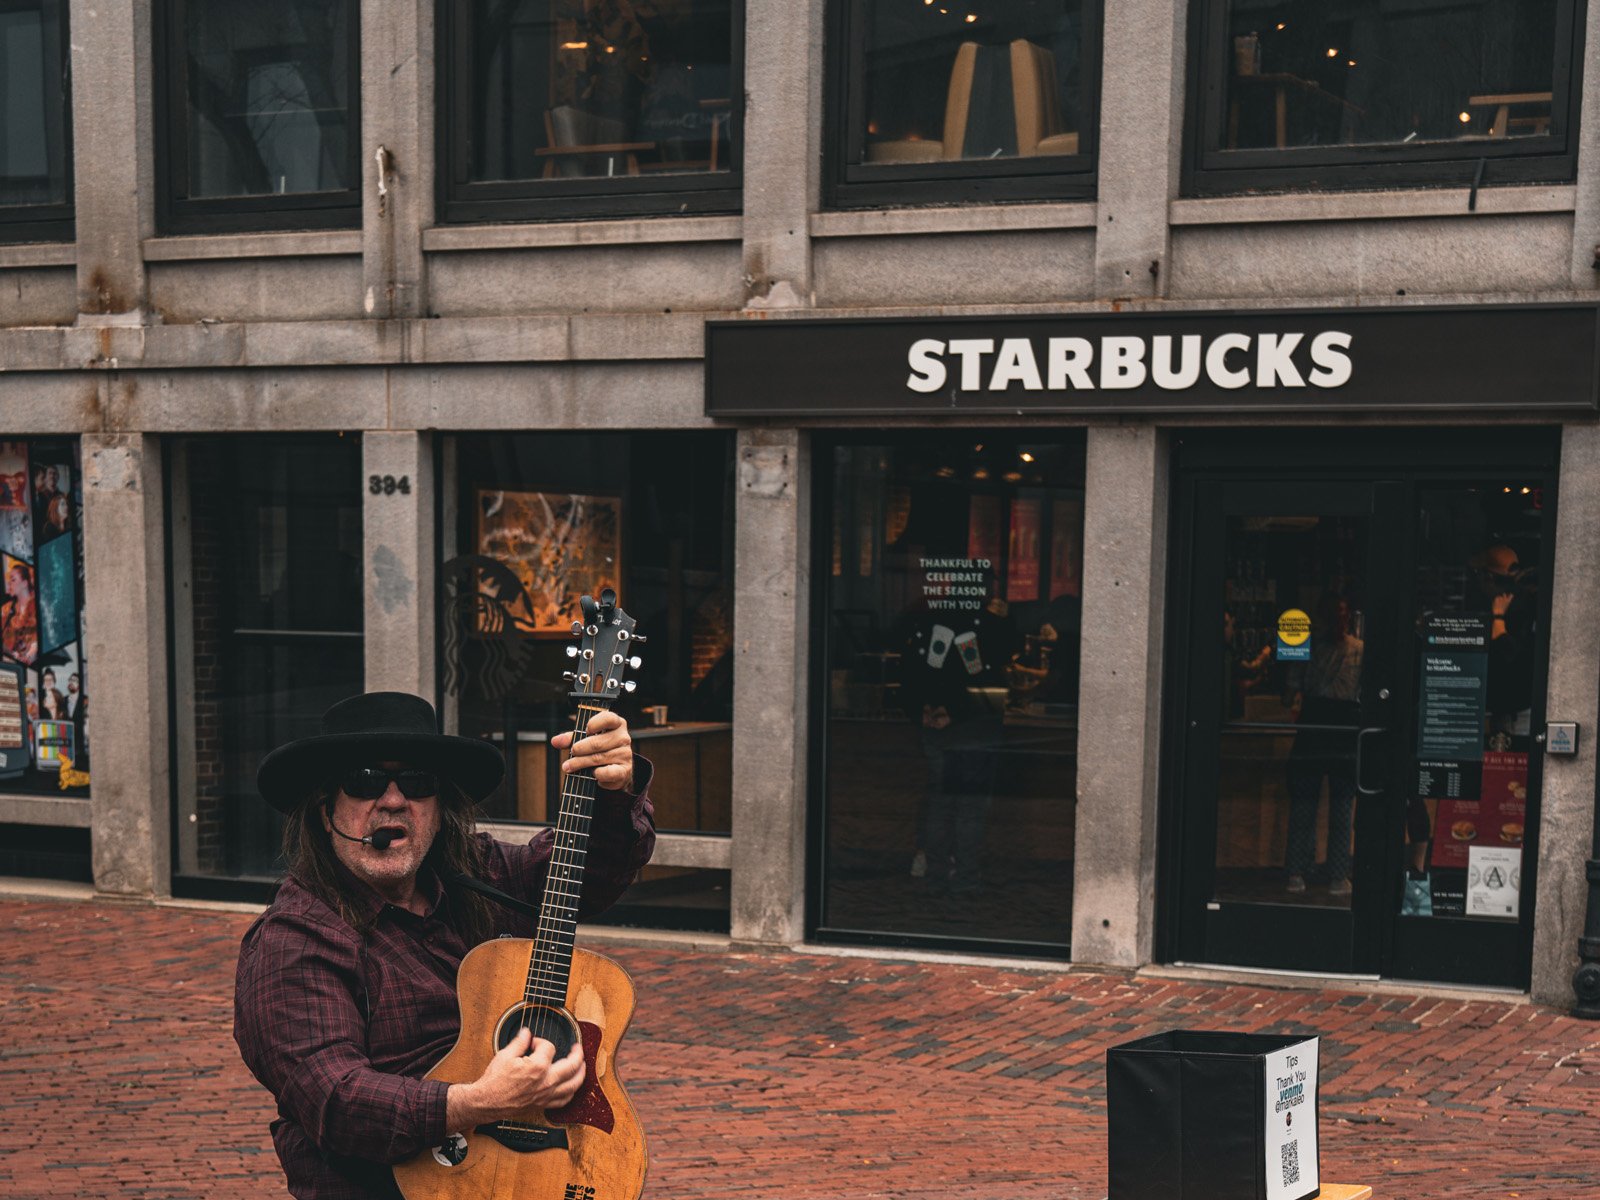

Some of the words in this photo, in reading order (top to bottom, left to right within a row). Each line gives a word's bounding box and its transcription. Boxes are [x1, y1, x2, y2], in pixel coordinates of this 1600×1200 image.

[906, 330, 1353, 393] STARBUCKS
[369, 474, 411, 496] 394
[919, 558, 974, 569] THANKFUL
[976, 559, 992, 569] TO
[926, 572, 984, 582] CELEBRATE
[923, 586, 942, 595] THE
[944, 586, 987, 596] SEASON
[927, 600, 956, 609] WITH
[958, 600, 981, 610] YOU
[1286, 1055, 1299, 1069] Tips
[1276, 1073, 1294, 1091] Thank
[1294, 1070, 1307, 1083] You
[1280, 1083, 1304, 1102] venmo
[1275, 1094, 1305, 1113] @markaleo
